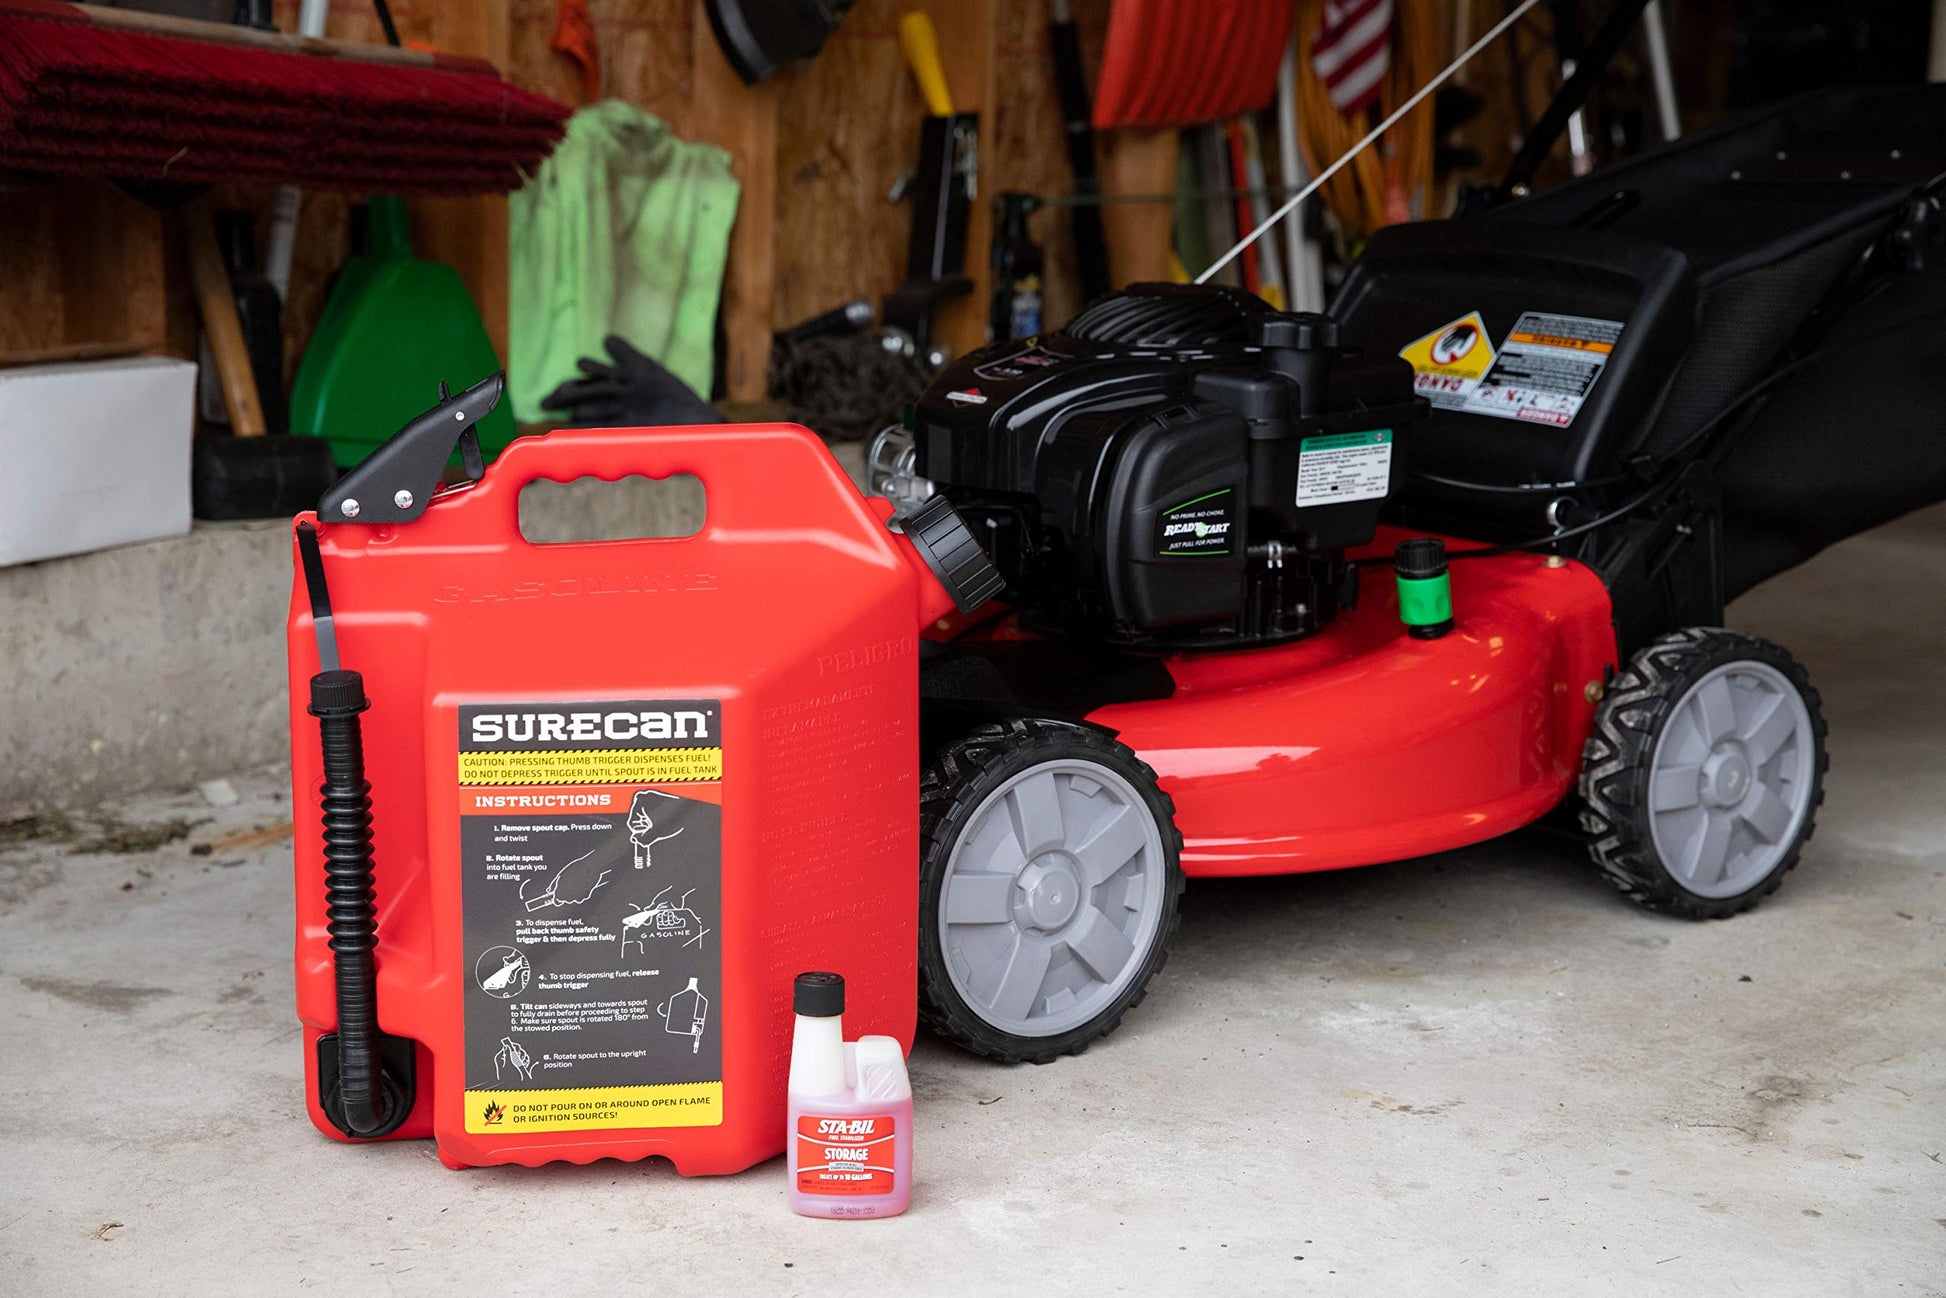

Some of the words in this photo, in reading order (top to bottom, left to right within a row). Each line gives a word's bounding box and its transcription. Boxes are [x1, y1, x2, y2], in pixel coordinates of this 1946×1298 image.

[1197, 510, 1206, 518] NO
[1168, 542, 1182, 551] JUST
[1182, 540, 1195, 548] PULL
[1195, 539, 1206, 547] FOR
[432, 571, 720, 607] GASOLINE
[817, 636, 913, 678] PELIGRO
[464, 758, 508, 767] CAUTION:
[509, 757, 554, 766] PRESSING
[557, 756, 591, 765] THUMB
[594, 755, 632, 765] TRIGGER
[634, 754, 683, 764] DISPENSES
[686, 753, 711, 763] FUEL!
[464, 770, 477, 778] DO
[480, 769, 498, 778] NOT
[501, 769, 542, 778] DEPRESS
[545, 768, 583, 777] TRIGGER
[586, 767, 612, 776] UNTIL
[615, 767, 644, 776] SPOUT
[647, 766, 656, 775] IS
[658, 766, 667, 775] IN
[670, 765, 691, 775] FUEL
[694, 765, 718, 774] TANK
[475, 793, 612, 808] INSTRUCTIONS
[501, 824, 531, 832] Remove
[532, 823, 554, 834] spout
[554, 823, 570, 834] cap.
[571, 822, 591, 831] Press
[592, 821, 613, 830] down
[495, 834, 508, 842] and
[509, 834, 528, 842] twist
[495, 854, 521, 862] Rotate
[522, 854, 544, 863] spout
[487, 863, 501, 872] into
[502, 863, 517, 871] fuel
[517, 863, 533, 871] tank
[533, 864, 547, 873] you
[487, 872, 499, 880] are
[499, 872, 521, 882] filling
[535, 919, 567, 928] dispense
[567, 918, 584, 926] fuel,
[516, 928, 531, 936] pull
[532, 927, 550, 935] back
[551, 926, 574, 935] thumb
[576, 926, 600, 935] safety
[640, 929, 691, 939] GASOLINE
[517, 936, 542, 945] trigger
[542, 935, 550, 943] &
[550, 935, 568, 943] then
[568, 934, 598, 944] depress
[598, 933, 616, 943] fully
[559, 973, 576, 982] stop
[577, 971, 615, 981] dispensing
[615, 970, 631, 978] fuel,
[632, 968, 660, 977] release
[538, 982, 563, 990] thumb
[563, 982, 590, 991] trigger
[549, 1002, 582, 1011] sideways
[597, 1001, 627, 1009] towards
[628, 1000, 648, 1008] spout
[519, 1010, 536, 1019] fully
[556, 1009, 580, 1017] before
[581, 1007, 619, 1017] proceeding
[629, 1007, 646, 1015] step
[520, 1017, 539, 1025] Make
[557, 1017, 579, 1026] spout
[587, 1015, 614, 1023] rotated
[614, 1014, 630, 1022] 180°
[631, 1013, 649, 1021] from
[551, 1023, 583, 1033] position.
[577, 1053, 599, 1062] spout
[620, 1049, 647, 1059] upright
[543, 1061, 573, 1070] position
[513, 1104, 527, 1112] DO
[529, 1103, 549, 1111] NOT
[551, 1102, 576, 1111] POUR
[578, 1102, 593, 1110] ON
[594, 1101, 608, 1109] OR
[609, 1100, 650, 1109] AROUND
[651, 1098, 677, 1107] OPEN
[679, 1096, 712, 1105] FLAME
[513, 1115, 527, 1123] OR
[528, 1113, 571, 1122] IGNITION
[573, 1111, 618, 1121] SOURCES!
[817, 1119, 875, 1135] STA-BIL
[824, 1148, 868, 1160] STORAGE
[851, 1173, 873, 1181] GALLONS
